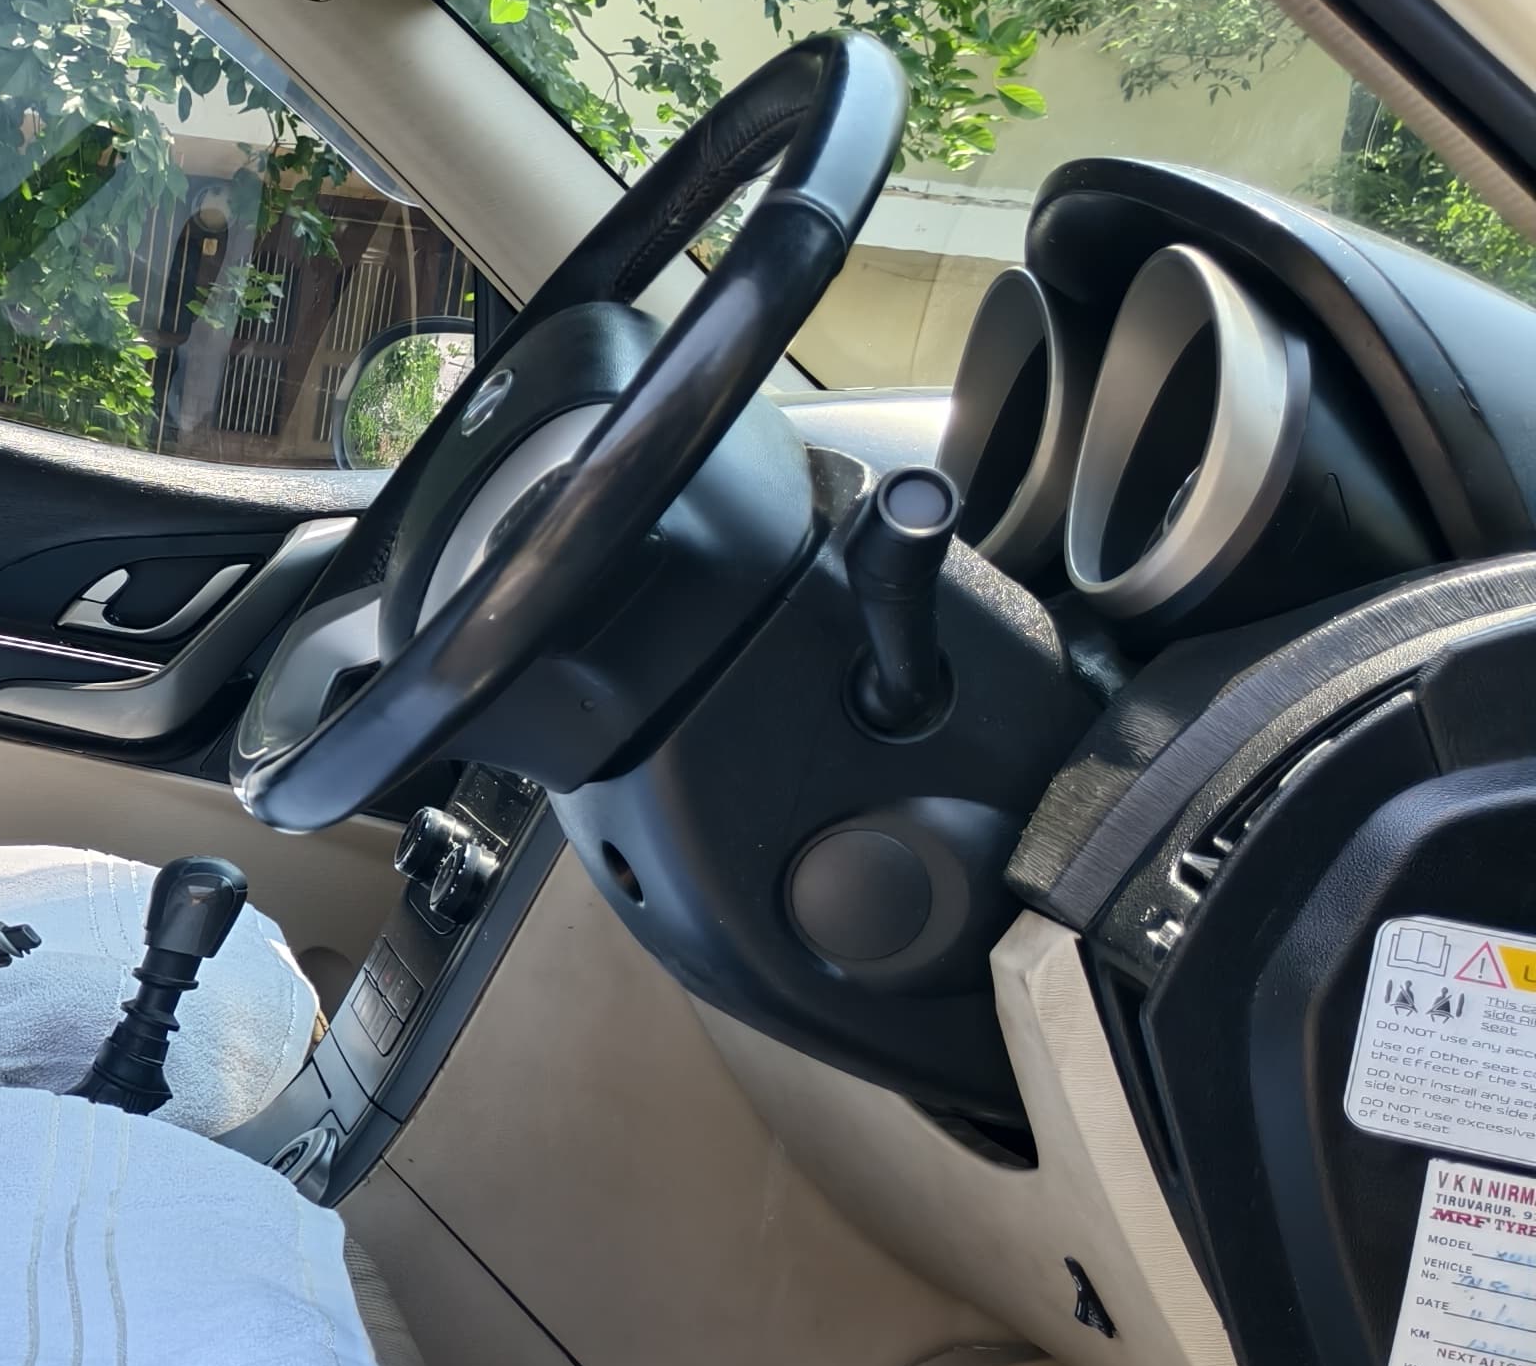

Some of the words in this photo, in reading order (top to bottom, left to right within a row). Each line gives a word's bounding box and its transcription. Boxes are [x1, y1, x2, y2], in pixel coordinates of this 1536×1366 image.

[1487, 996, 1517, 1011] This
[1484, 1009, 1515, 1022] side
[1376, 1020, 1400, 1032] DO
[1403, 1025, 1437, 1039] NOT
[1440, 1034, 1468, 1046] use
[1472, 1040, 1501, 1054] any
[1505, 1046, 1536, 1059] acc
[1481, 1021, 1518, 1036] seat
[1370, 1050, 1399, 1064] the
[1402, 1057, 1460, 1076] Effect
[1463, 1070, 1483, 1081] of
[1488, 1074, 1517, 1087] the
[1372, 1038, 1402, 1052] Use
[1406, 1044, 1425, 1055] of
[1430, 1050, 1478, 1066] Other
[1481, 1061, 1520, 1076] seat
[1366, 1067, 1390, 1079] DO
[1394, 1072, 1427, 1086] NOT
[1430, 1079, 1478, 1097] install
[1480, 1090, 1511, 1105] any
[1364, 1079, 1396, 1093] side
[1399, 1085, 1418, 1096] or
[1422, 1092, 1460, 1105] near
[1464, 1099, 1493, 1112] the
[1496, 1105, 1529, 1120] side
[1358, 1108, 1378, 1119] of
[1382, 1112, 1410, 1126] the
[1413, 1120, 1451, 1134] seat
[1360, 1096, 1384, 1108] DO
[1387, 1101, 1421, 1115] NOT
[1424, 1110, 1453, 1122] use
[1456, 1116, 1536, 1139] excessive
[1438, 1170, 1449, 1189] V
[1453, 1174, 1466, 1193] K
[1470, 1177, 1483, 1196] N
[1487, 1180, 1536, 1207] NIRM
[1435, 1193, 1516, 1218] TIRUVARUR.
[1429, 1207, 1491, 1229] MRF
[1427, 1234, 1474, 1251] MODEL
[1423, 1256, 1473, 1275] VEHICLE
[1416, 1296, 1449, 1311] DATE
[1410, 1327, 1430, 1340] KM
[1436, 1347, 1476, 1364] NEXT
